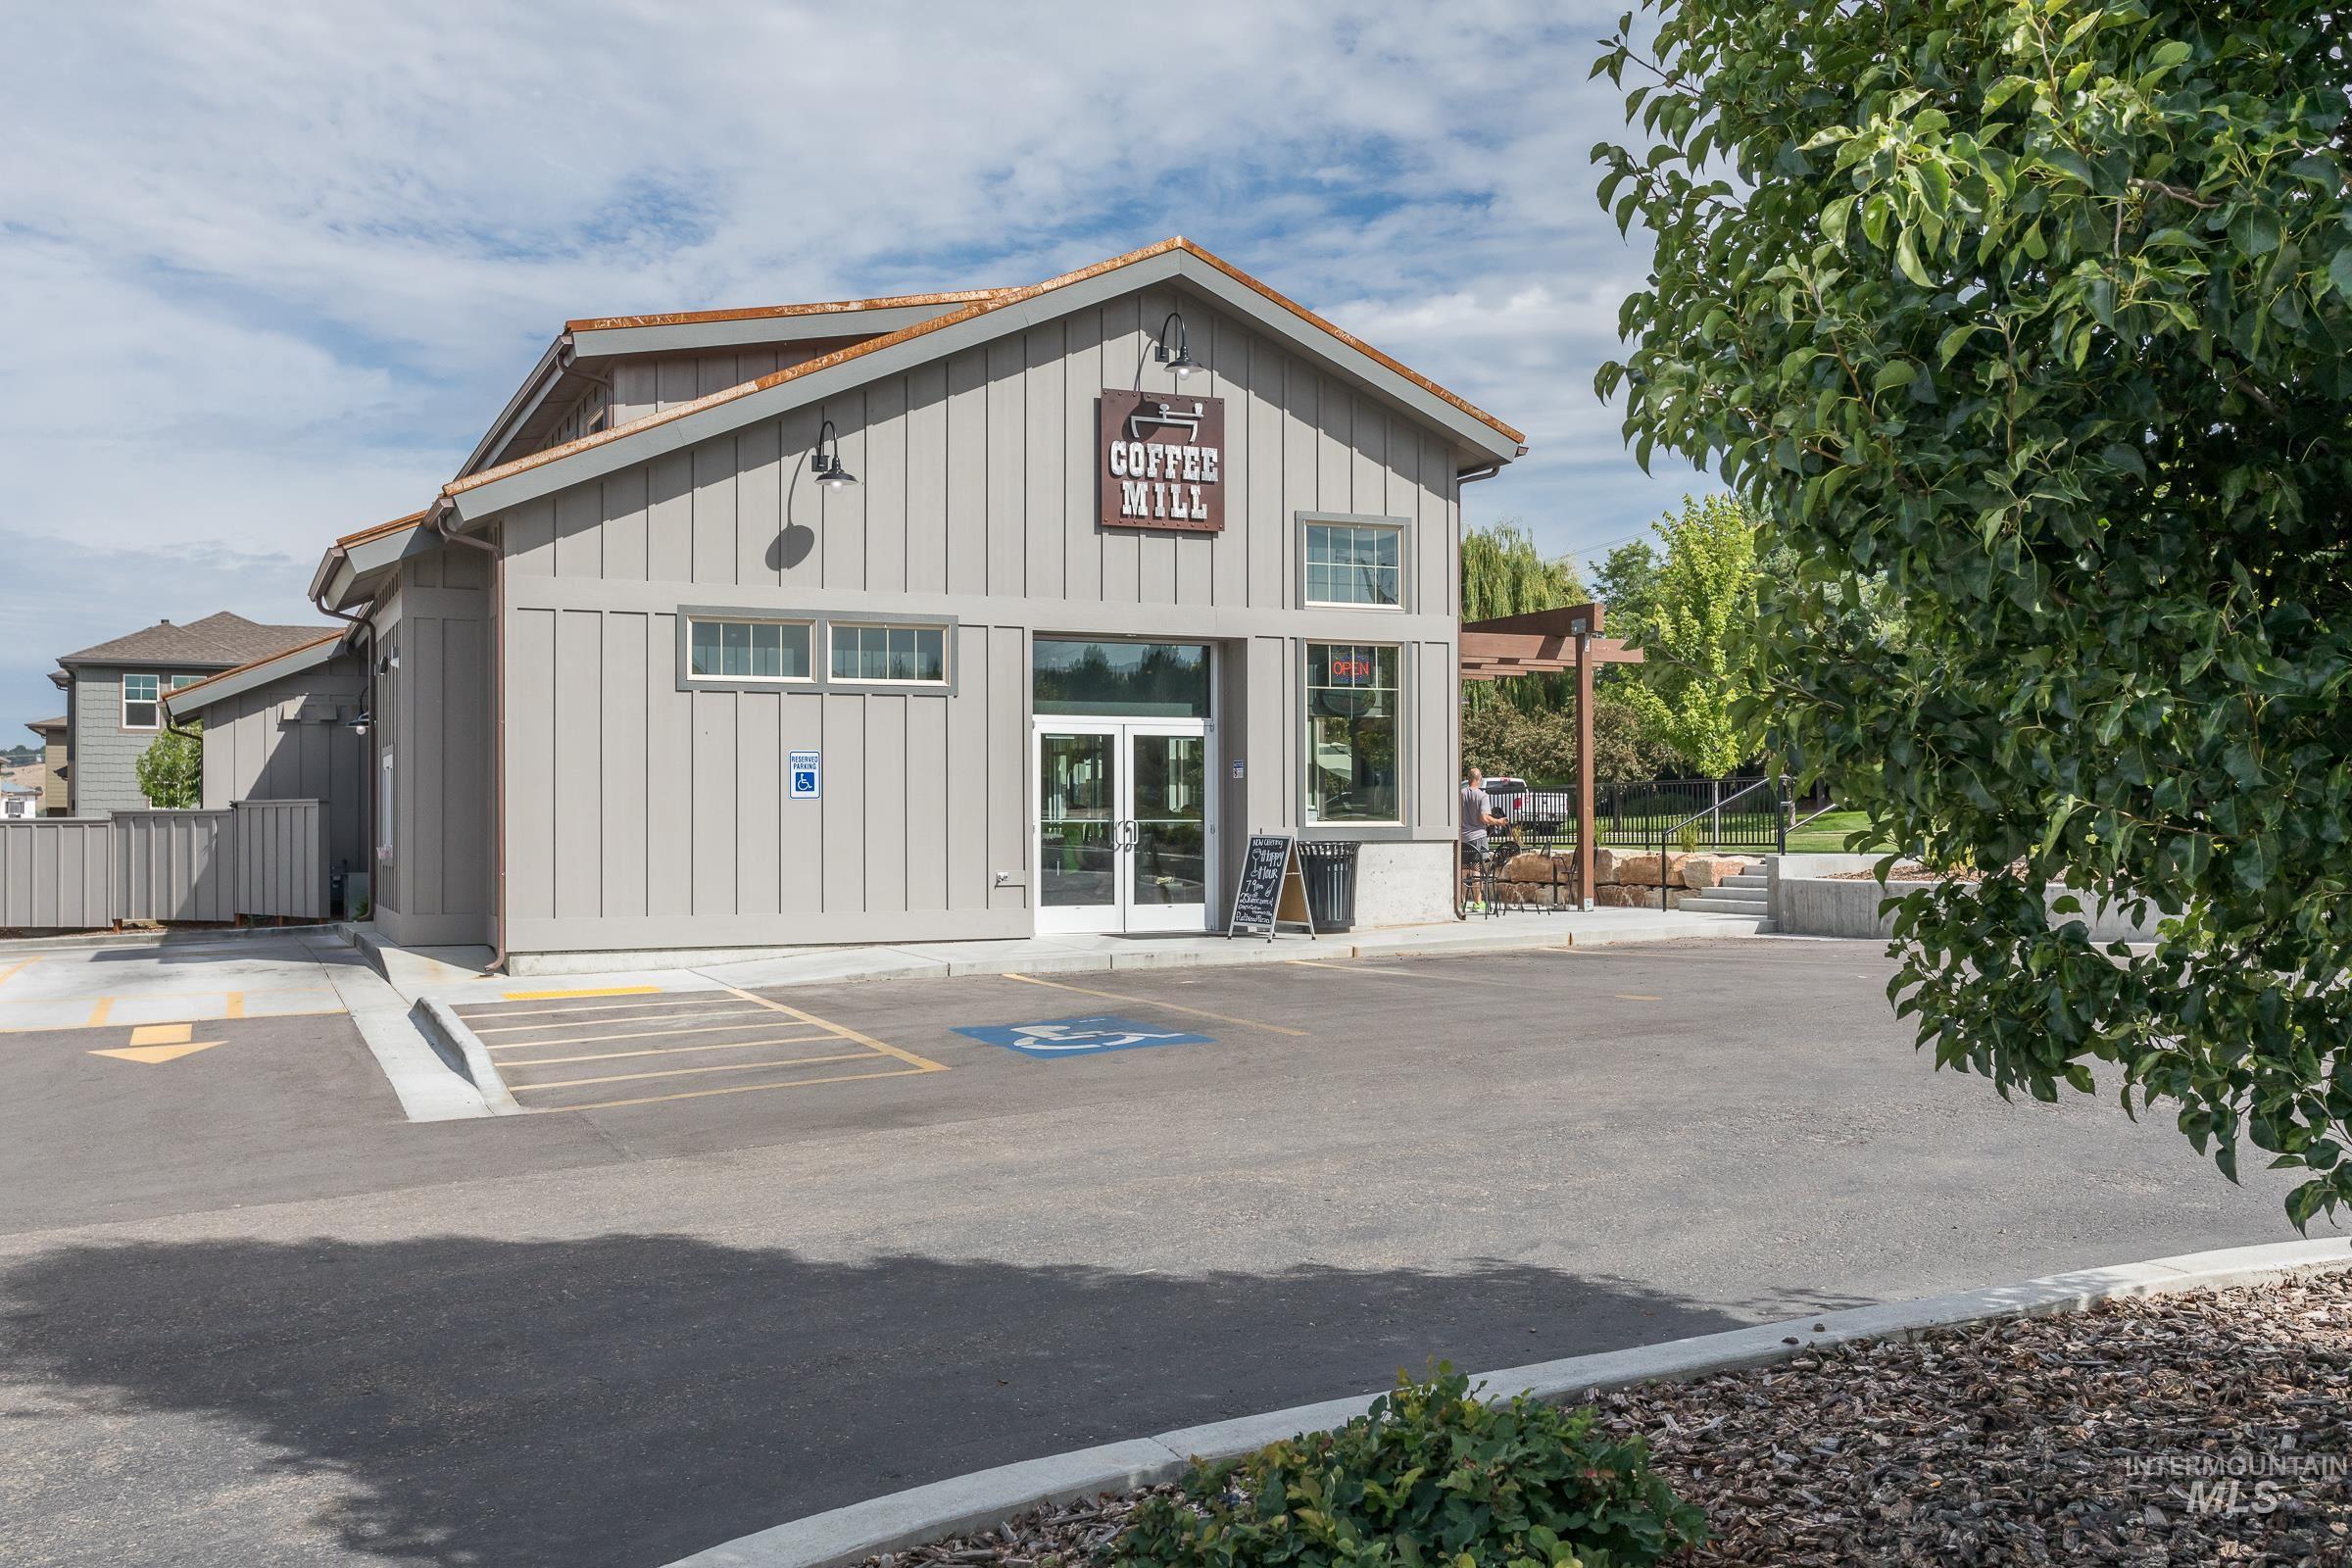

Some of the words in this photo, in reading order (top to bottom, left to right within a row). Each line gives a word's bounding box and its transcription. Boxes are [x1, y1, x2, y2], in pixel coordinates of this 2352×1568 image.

[1110, 440, 1218, 482] COFFEE
[1122, 480, 1207, 519] MILL
[1333, 661, 1370, 675] OPEN
